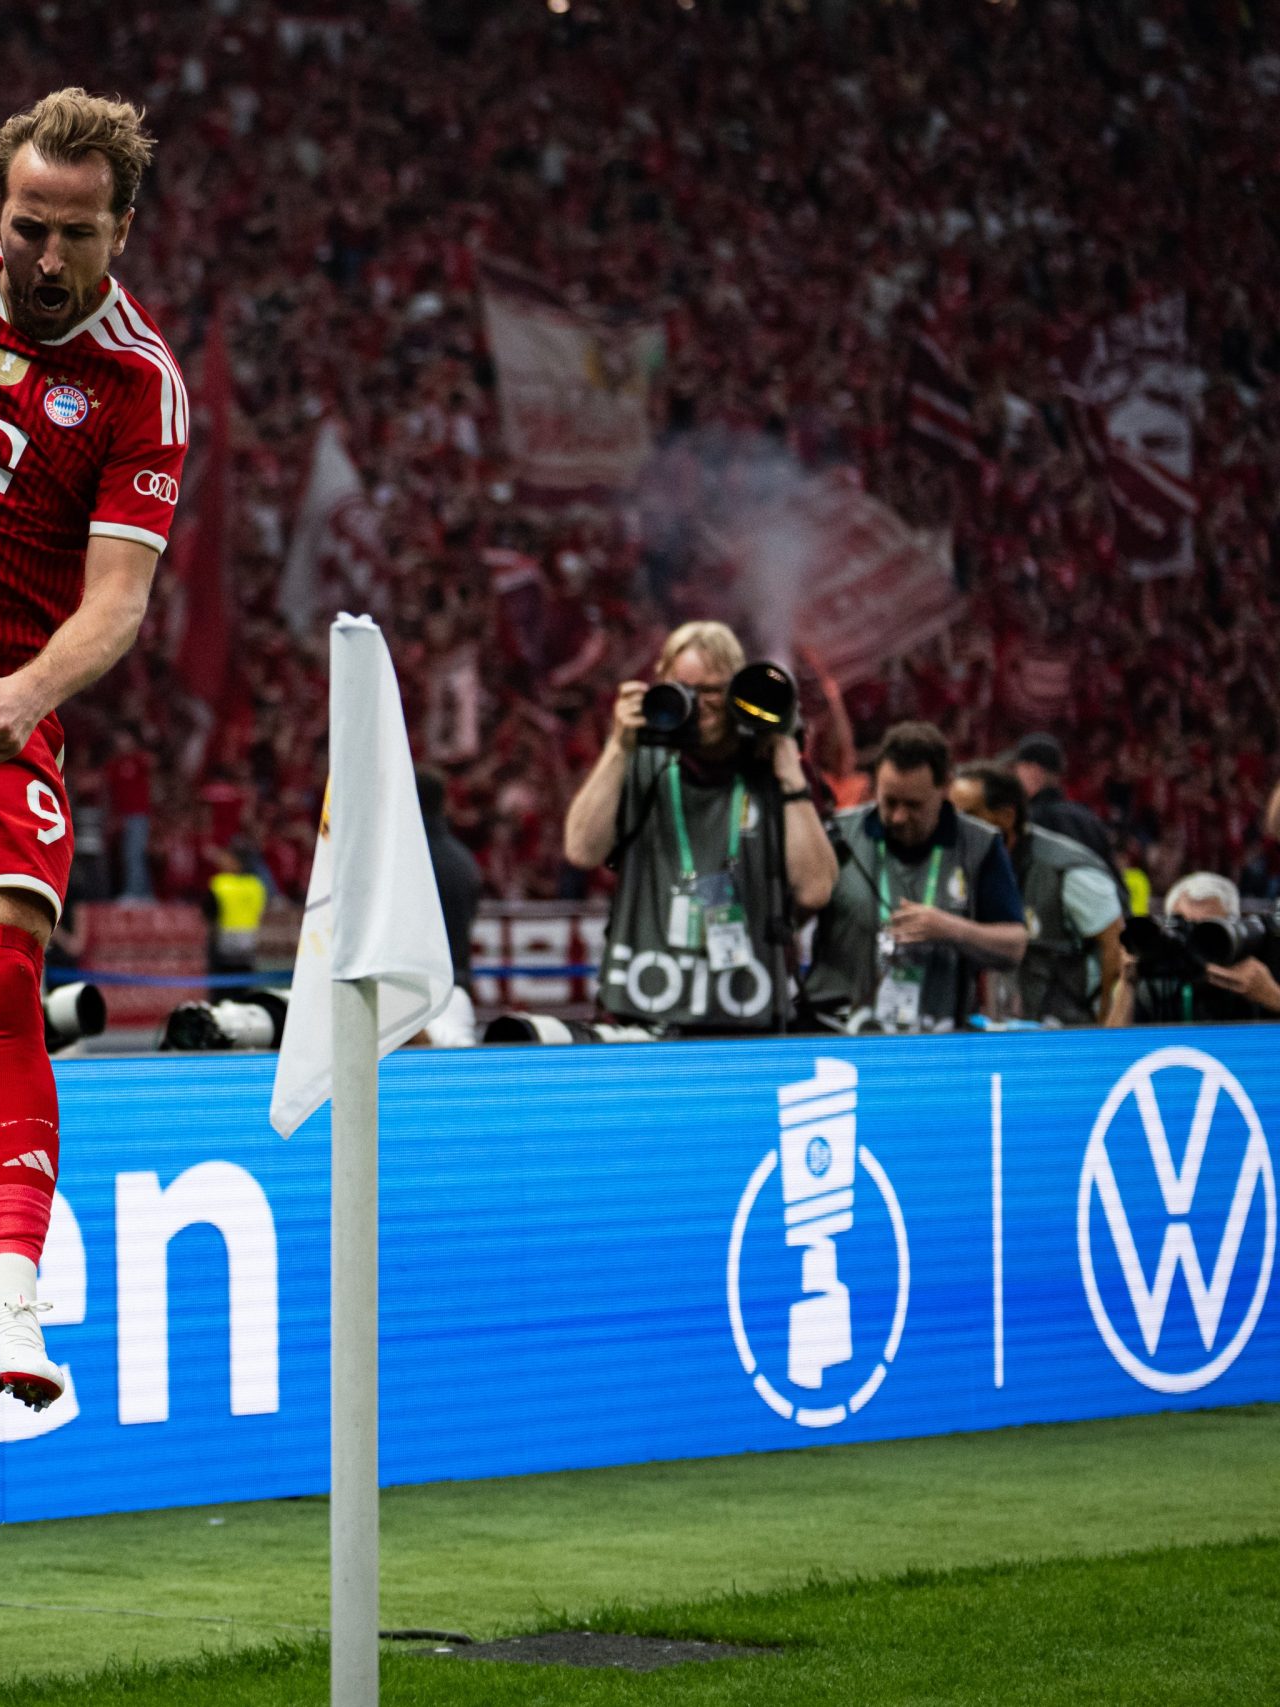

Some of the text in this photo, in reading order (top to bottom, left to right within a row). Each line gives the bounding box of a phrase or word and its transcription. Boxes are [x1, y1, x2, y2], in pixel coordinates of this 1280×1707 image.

[51, 388, 86, 412] FC BAYERN
[26, 779, 66, 846] 9
[1086, 1054, 1266, 1358] VW
